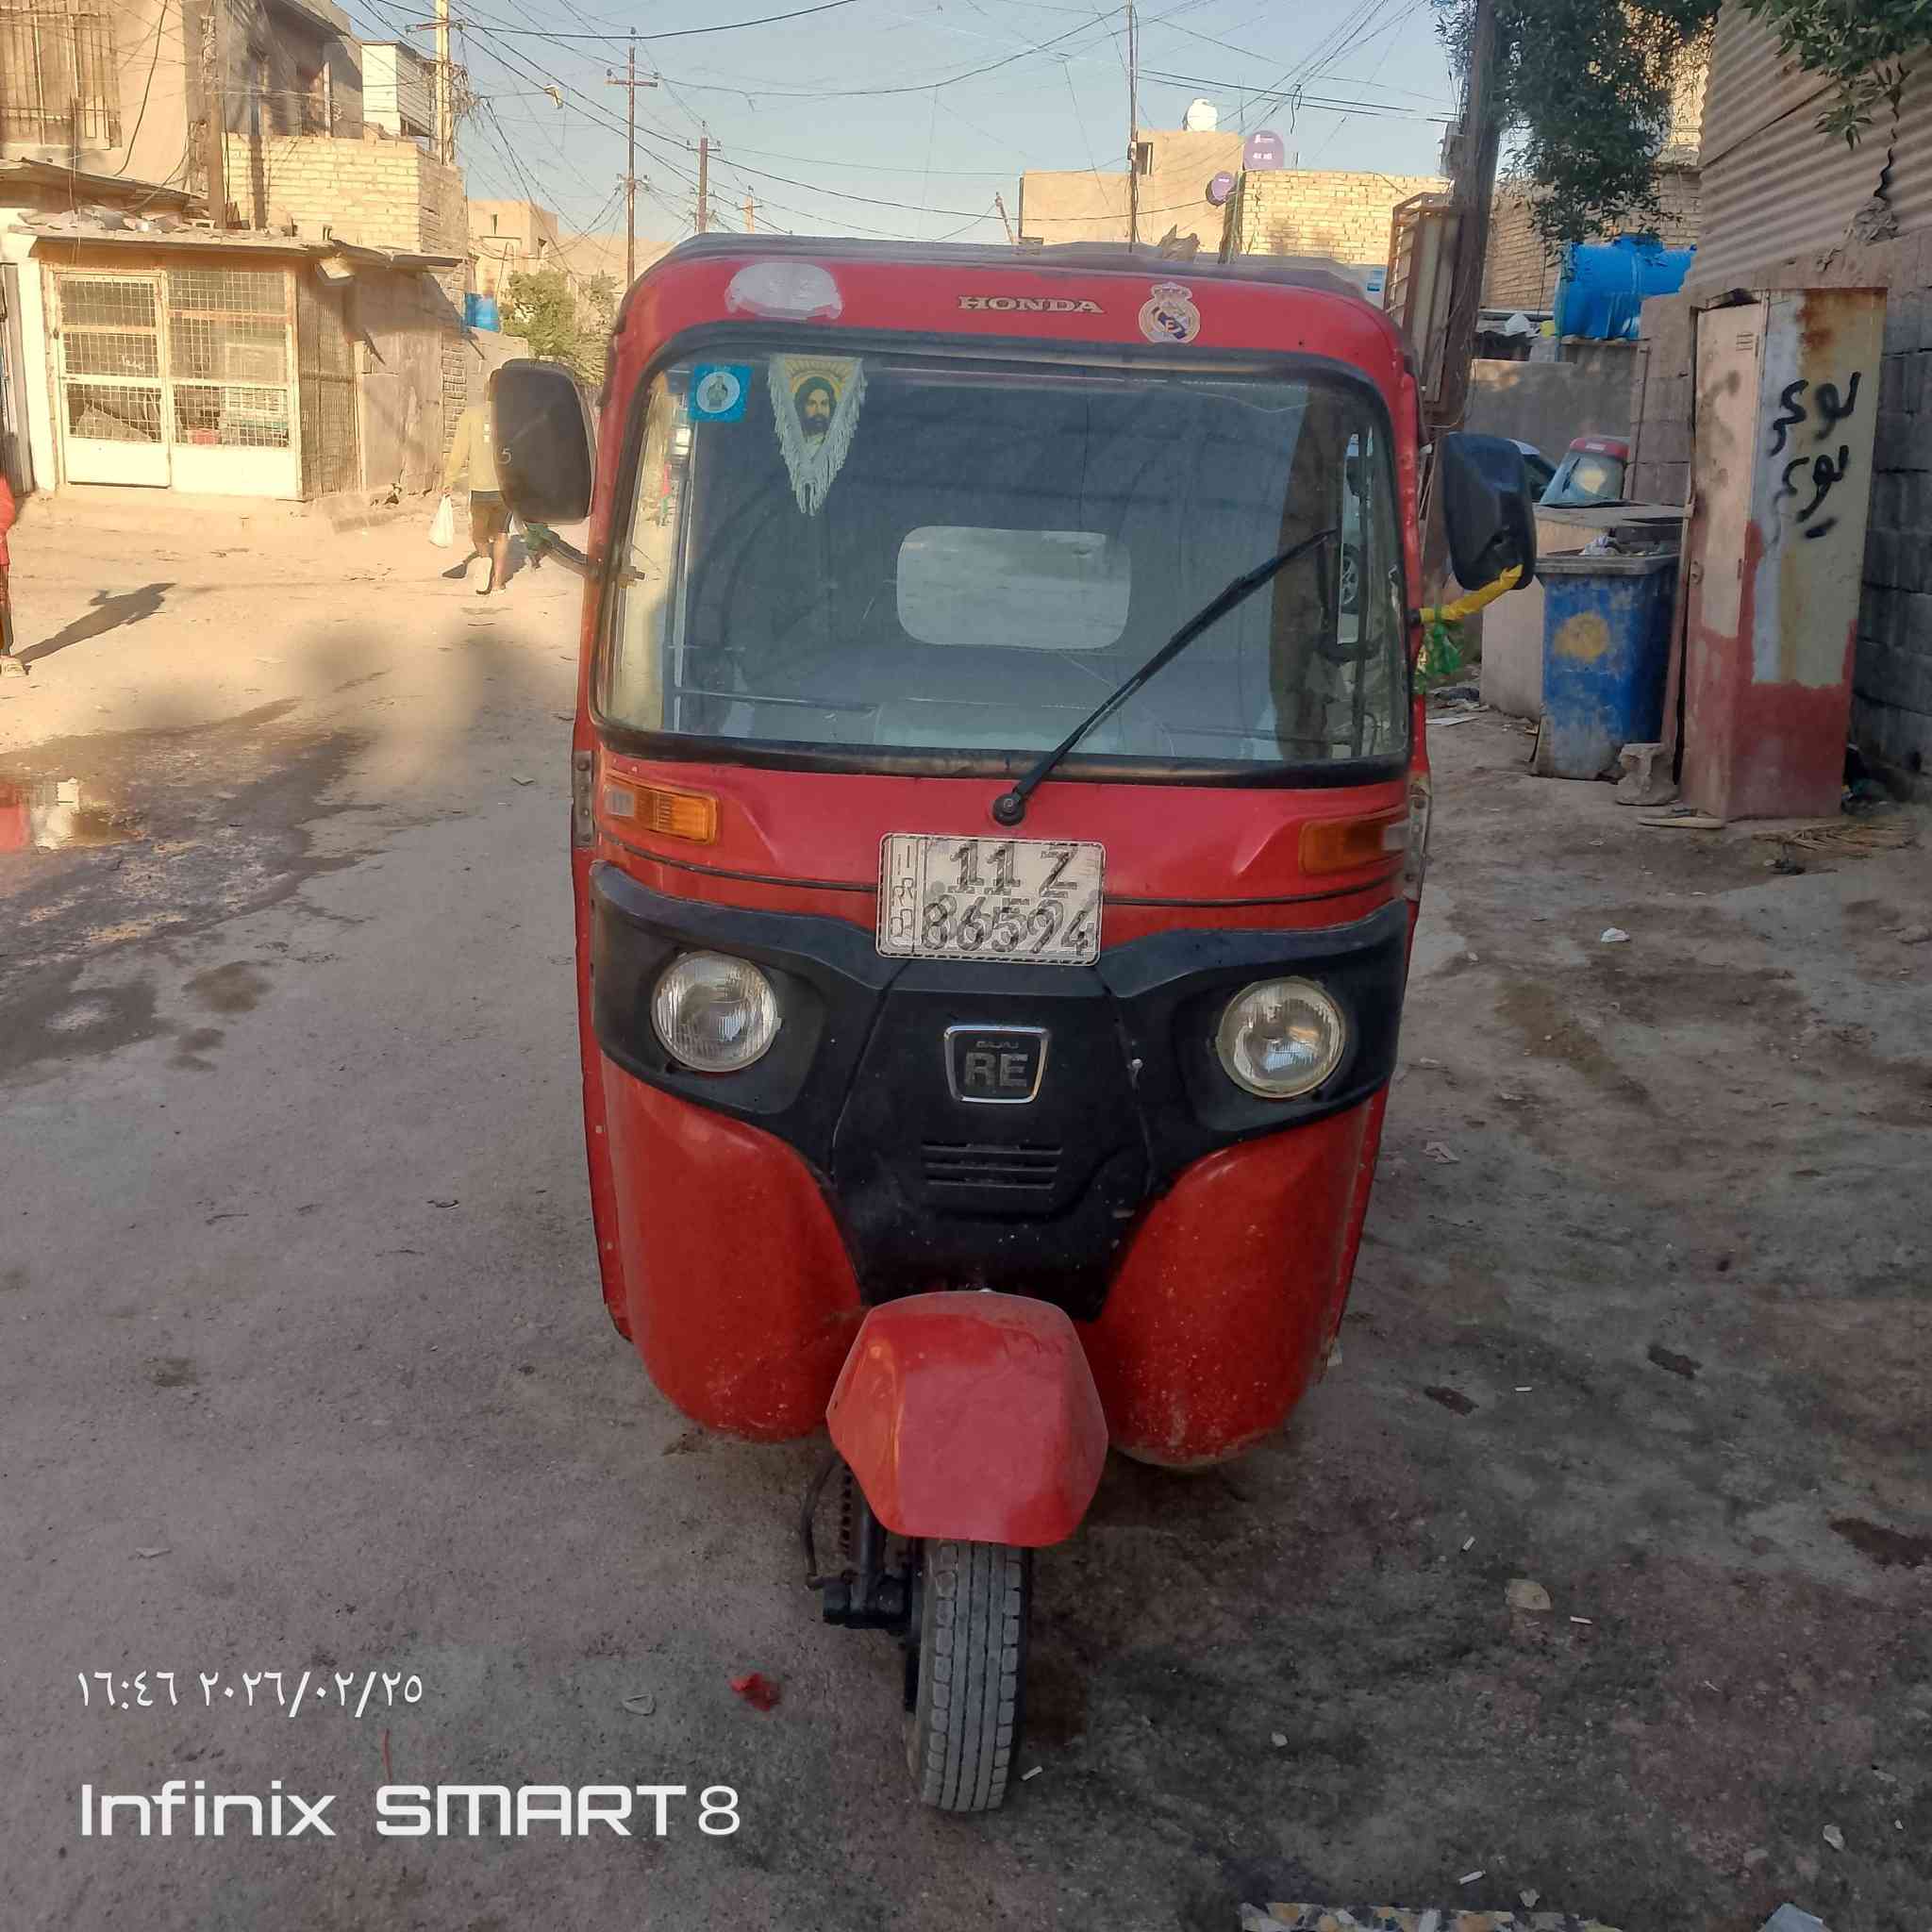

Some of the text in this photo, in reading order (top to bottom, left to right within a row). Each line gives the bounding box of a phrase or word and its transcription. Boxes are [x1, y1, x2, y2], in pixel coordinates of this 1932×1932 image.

[958, 295, 1107, 314] HONDA
[947, 840, 1078, 898] 11 Z
[921, 893, 1097, 956] 86594
[964, 1052, 1028, 1087] RE
